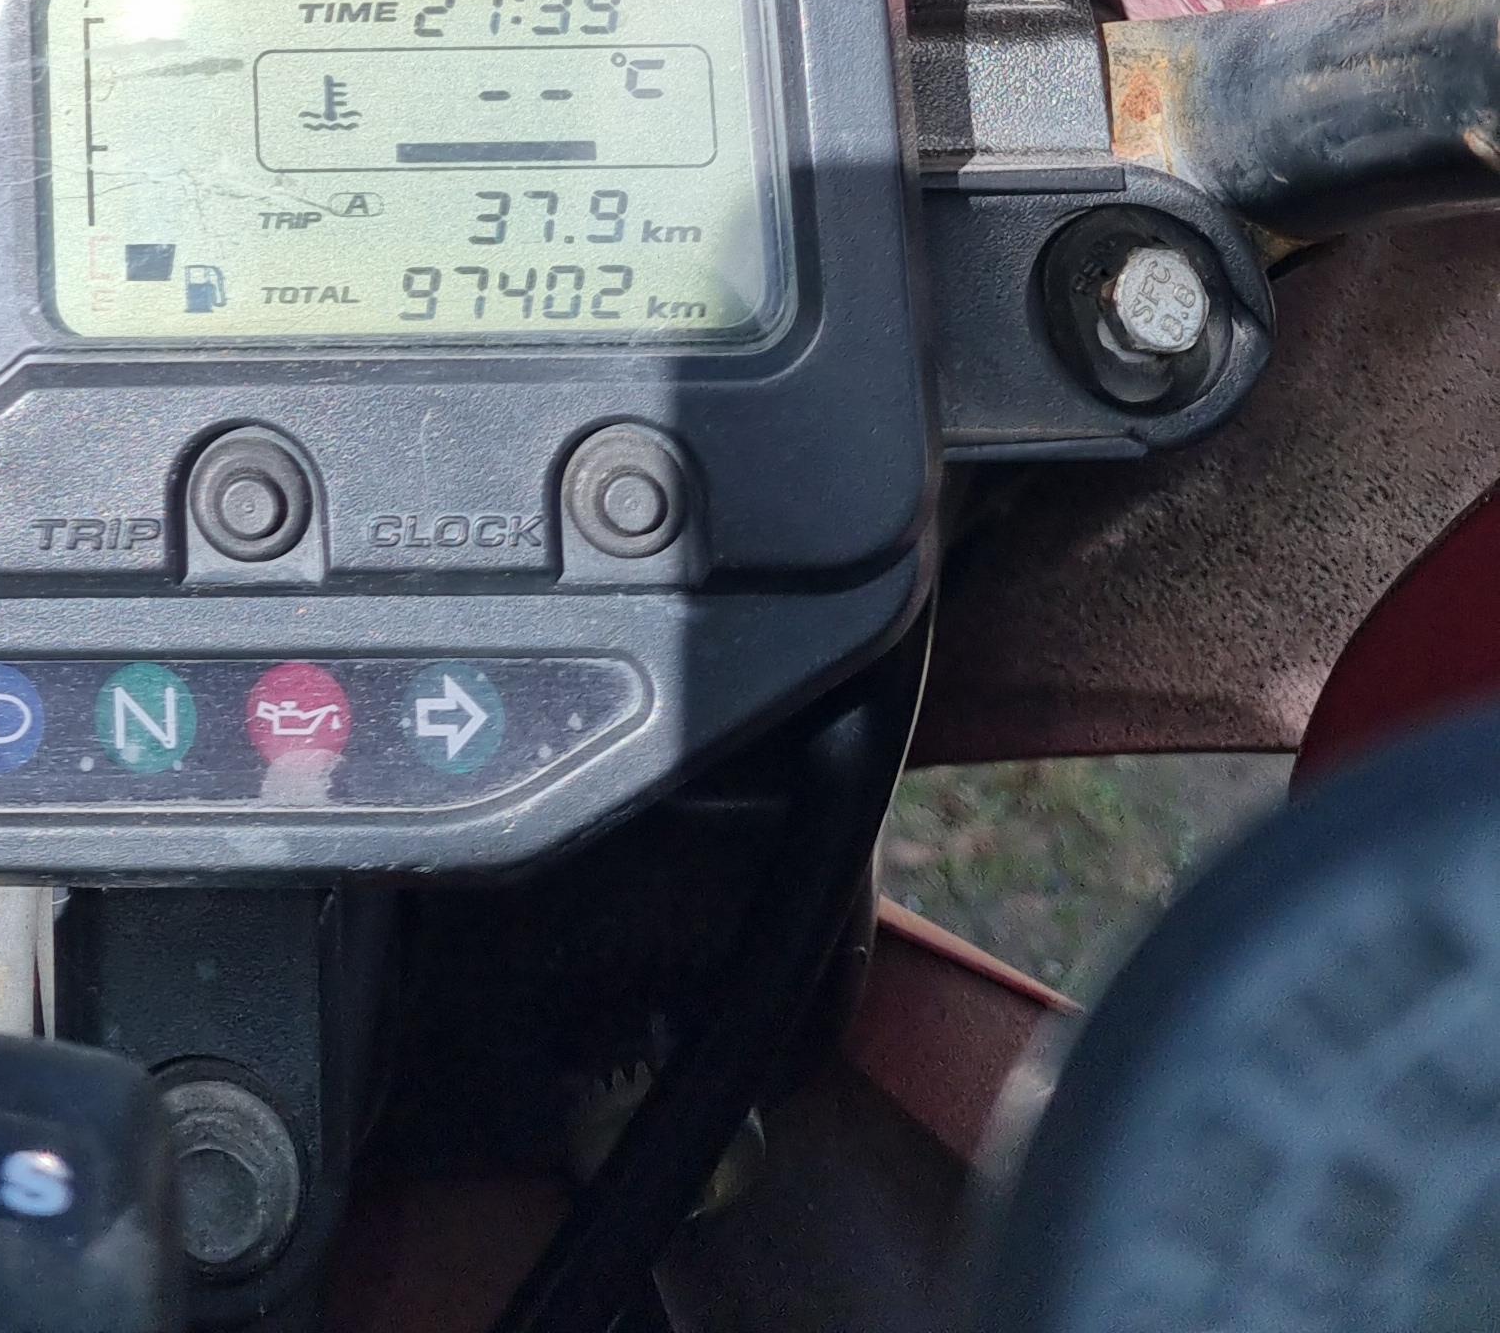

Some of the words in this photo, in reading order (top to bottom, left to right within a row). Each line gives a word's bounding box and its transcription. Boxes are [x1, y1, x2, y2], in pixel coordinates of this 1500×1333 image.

[299, 2, 398, 23] TIME
[258, 212, 323, 230] TRIP
[344, 193, 370, 214] A
[468, 189, 629, 244] 37.9
[641, 220, 701, 244] km
[261, 286, 360, 305] TOTAL
[399, 264, 634, 320] 97402
[647, 296, 707, 319] km
[29, 517, 163, 551] TRIP
[367, 514, 547, 549] CLOCK
[113, 686, 178, 750] N
